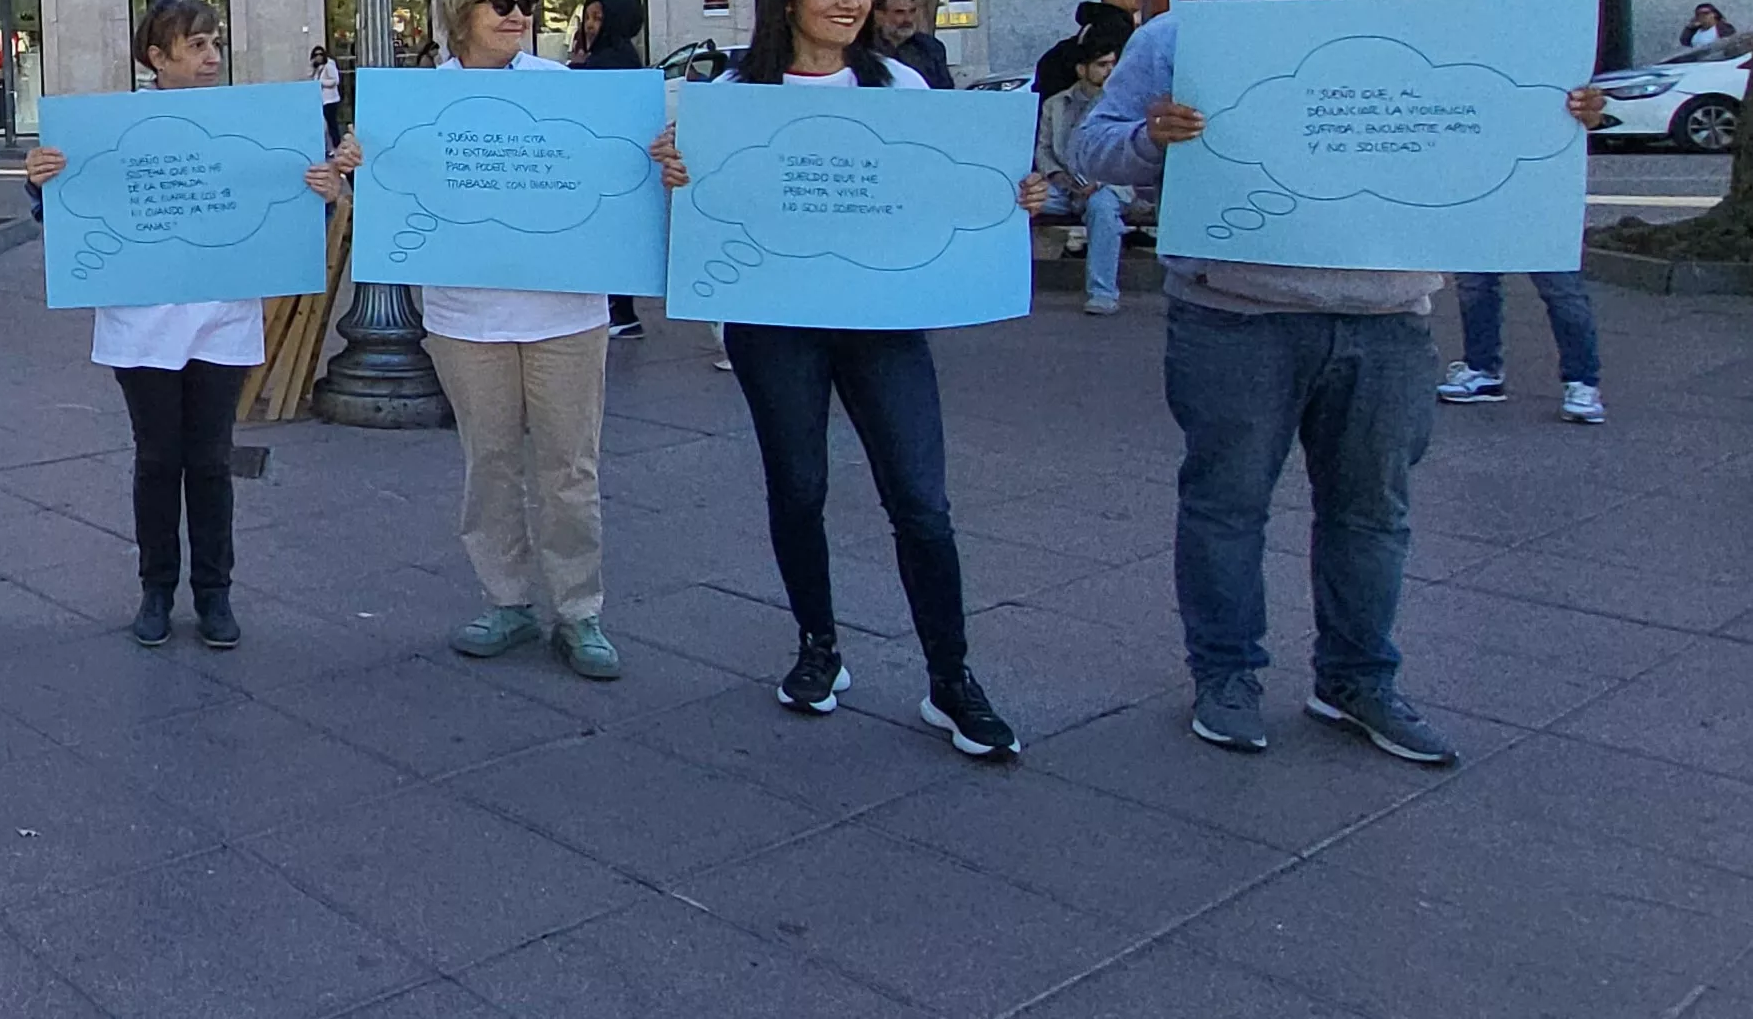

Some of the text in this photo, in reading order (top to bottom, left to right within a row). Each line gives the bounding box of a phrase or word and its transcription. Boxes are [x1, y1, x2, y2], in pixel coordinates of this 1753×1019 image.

[1400, 87, 1422, 98] AL
[1307, 105, 1476, 119] DENUNCIAR LA VIOLENCIA
[1365, 123, 1440, 134] ENCUENTRE
[1444, 122, 1482, 135] APOYO
[483, 134, 503, 143] QUE
[507, 135, 519, 143] MI
[523, 135, 546, 143] CITA
[1308, 141, 1320, 154] Y
[1326, 142, 1347, 153] NO
[163, 155, 182, 163] CON
[186, 152, 200, 162] UN
[830, 156, 854, 167] CON
[861, 158, 879, 168] UN
[169, 166, 188, 176] QUE
[192, 165, 205, 173] NO
[446, 161, 553, 174] PARA PODER VIVIR Y
[446, 178, 501, 190] TRABAJAR
[506, 180, 526, 189] CON
[783, 172, 879, 184] SUELDO QUE ME
[782, 202, 797, 212] NO
[802, 202, 827, 213] SOLO
